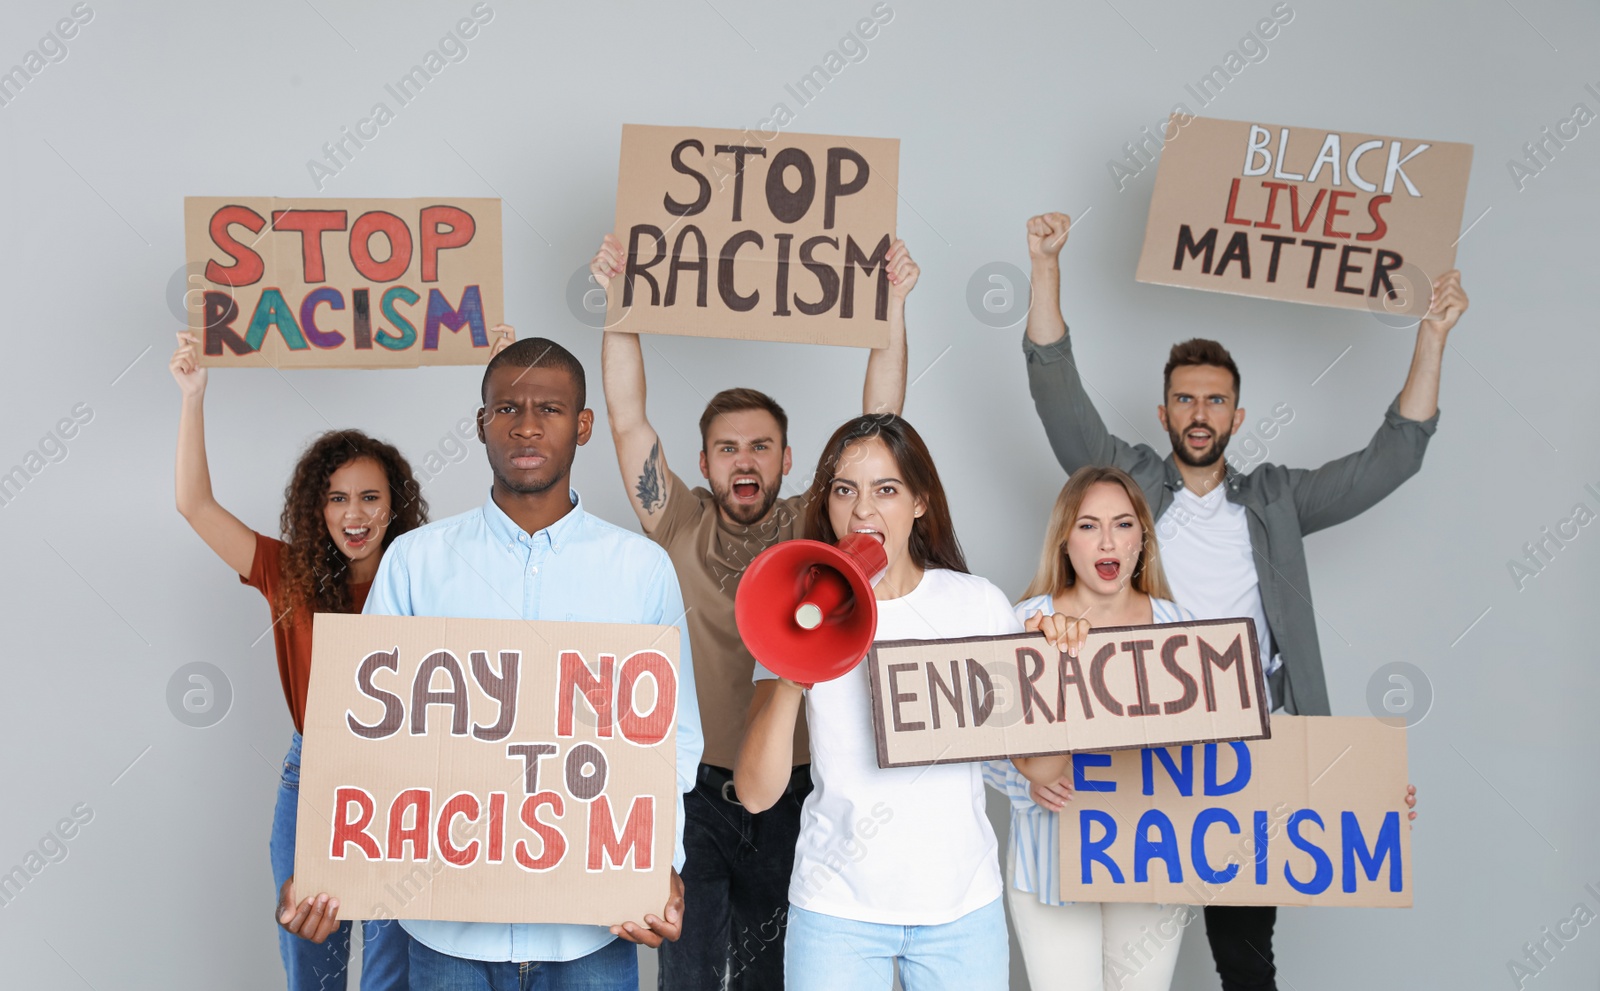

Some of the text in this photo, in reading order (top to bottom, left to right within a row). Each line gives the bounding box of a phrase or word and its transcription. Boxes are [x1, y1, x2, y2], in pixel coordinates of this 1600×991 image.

[663, 138, 870, 230] STOP
[1242, 124, 1432, 198] BLACK
[204, 204, 477, 287] STOP
[1224, 178, 1393, 242] LIVES
[622, 223, 892, 322] RACISM
[1172, 223, 1404, 300] MATTER
[202, 284, 490, 357] RACISM
[345, 645, 680, 747] SAY NO
[887, 632, 1252, 733] END RACISM
[506, 740, 609, 802] TO
[329, 785, 656, 873] RACISM
[1079, 807, 1403, 895] RACISM
